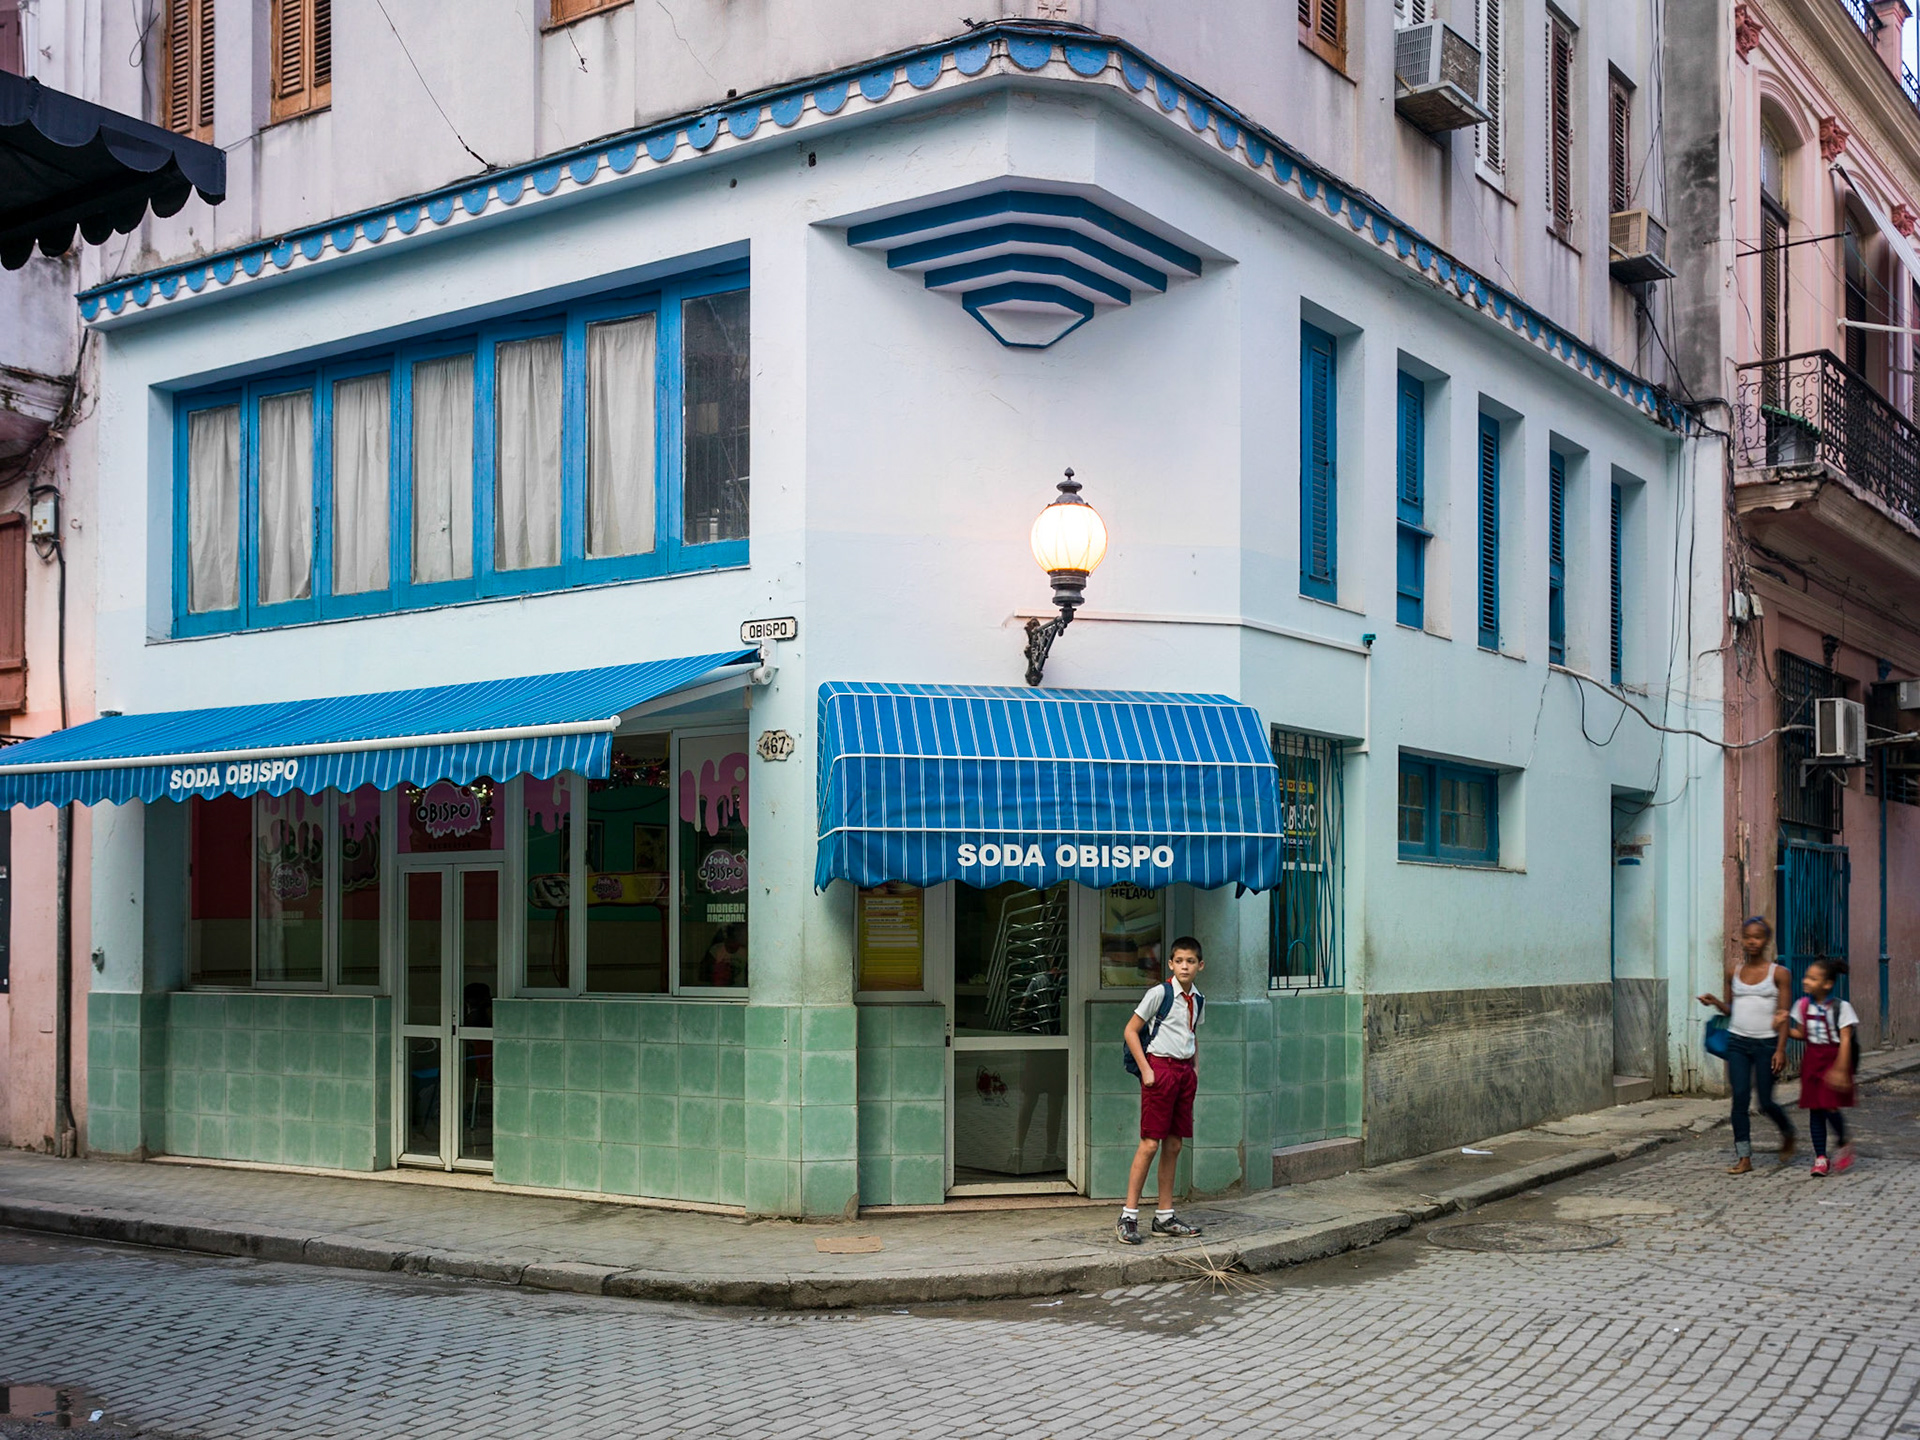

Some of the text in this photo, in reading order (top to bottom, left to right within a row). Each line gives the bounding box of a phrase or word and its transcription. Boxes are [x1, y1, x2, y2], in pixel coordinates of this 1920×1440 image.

[749, 621, 788, 639] OBISPO
[762, 735, 787, 755] 467
[169, 759, 299, 790] SODA OBISPO
[417, 802, 471, 823] OBISPO
[708, 854, 730, 865] Soda
[957, 843, 1175, 868] SODA OBISPO
[699, 866, 744, 880] OBISPO
[1110, 888, 1156, 900] HELADO
